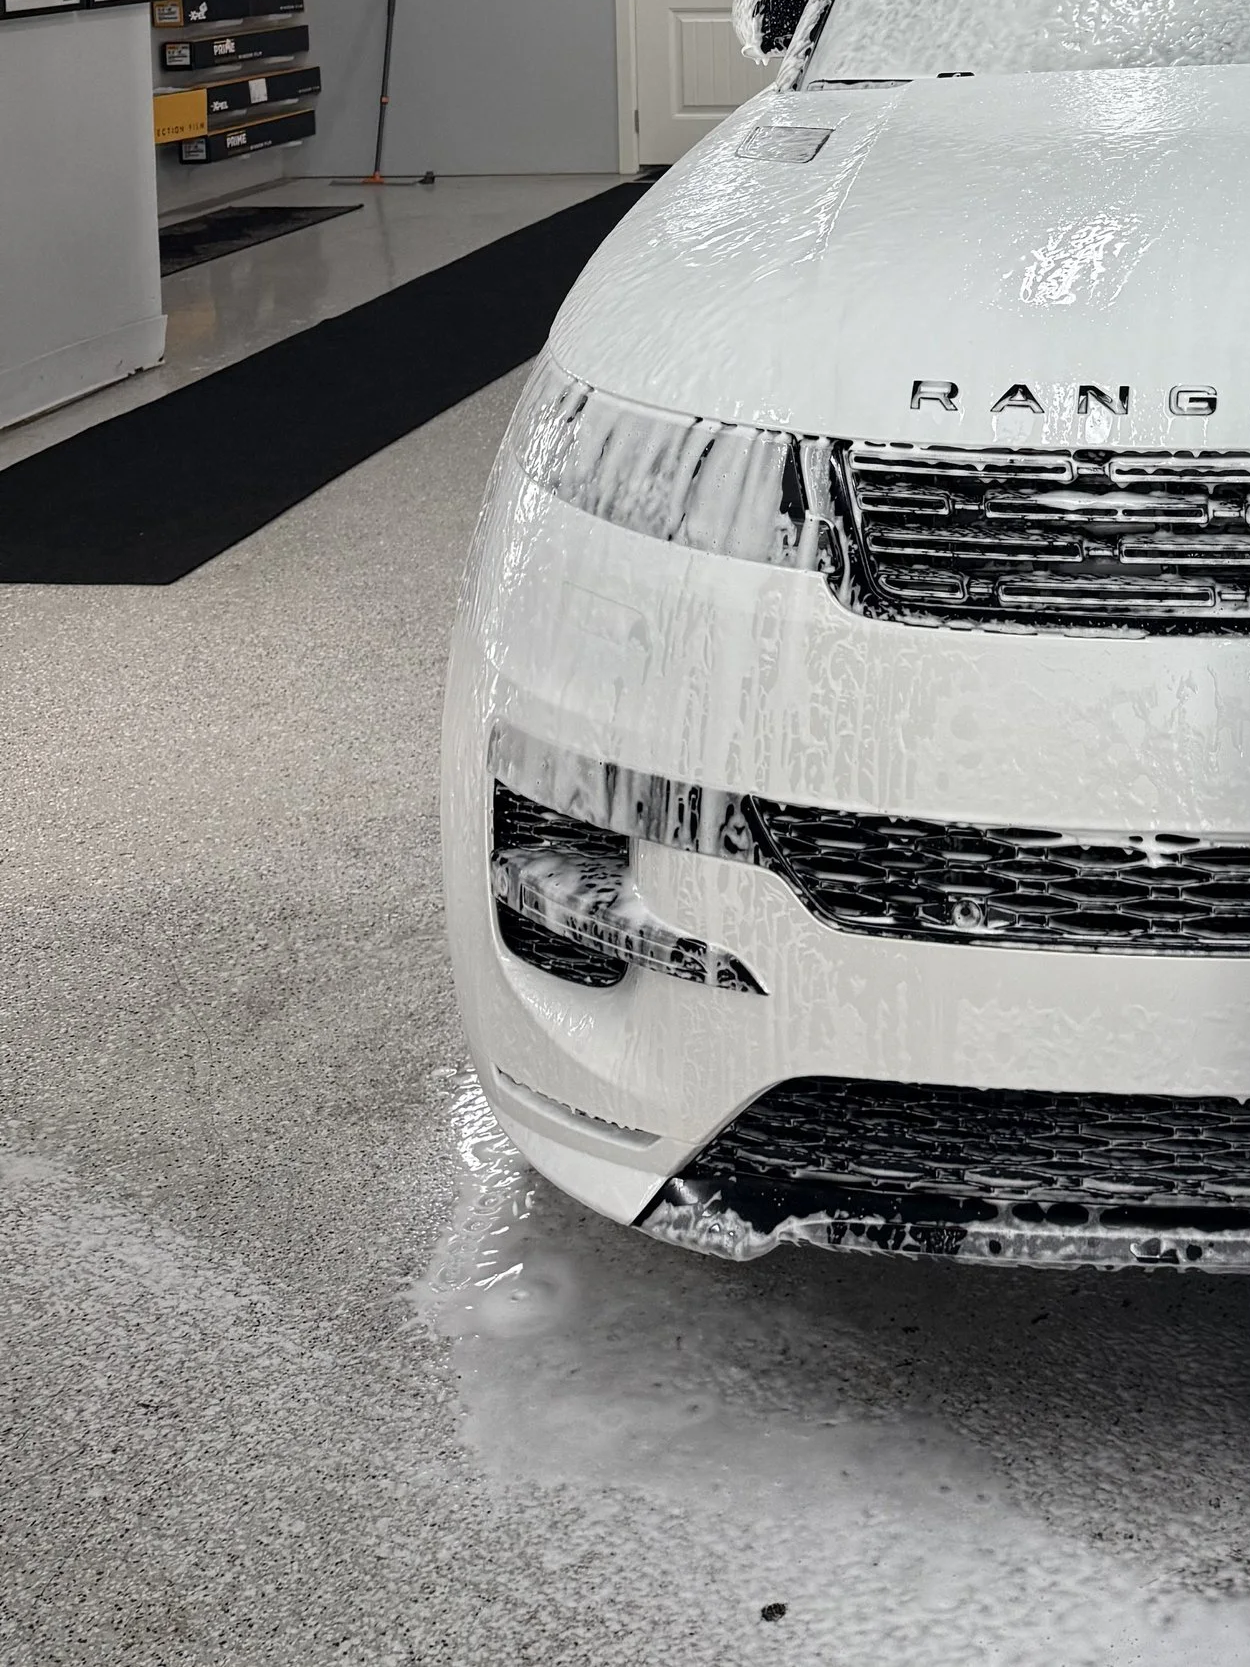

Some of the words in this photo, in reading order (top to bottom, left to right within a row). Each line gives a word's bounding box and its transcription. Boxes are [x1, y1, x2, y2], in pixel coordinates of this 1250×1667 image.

[213, 41, 236, 56] PRIME
[210, 100, 229, 112] XPEL
[226, 132, 247, 148] PRIME
